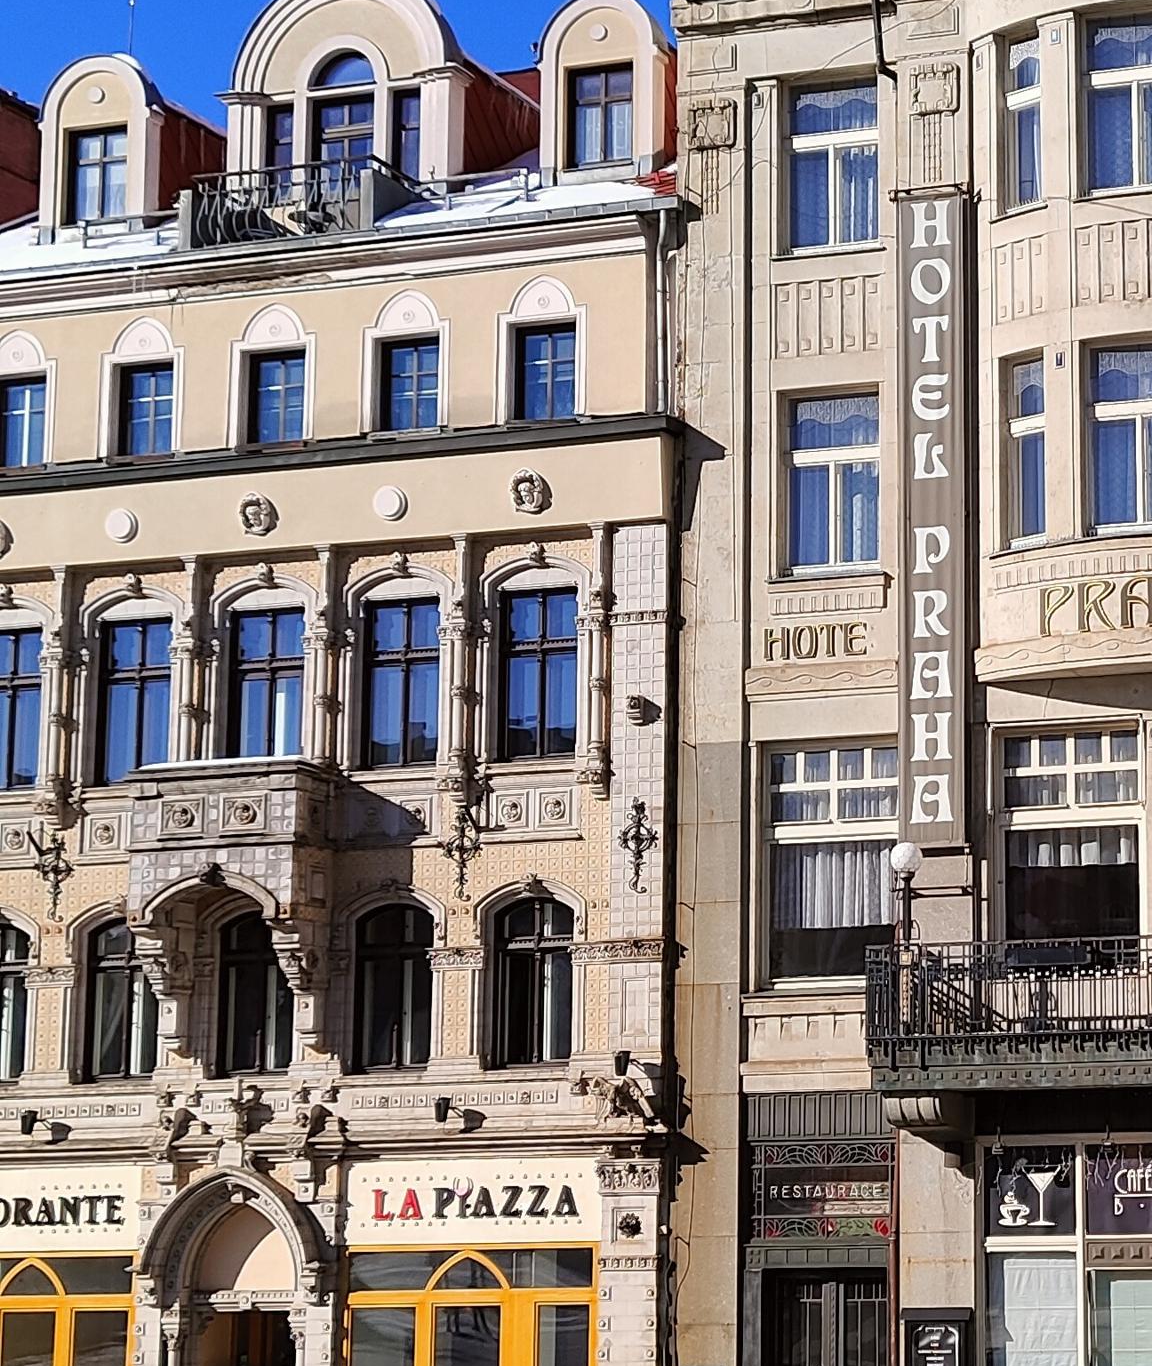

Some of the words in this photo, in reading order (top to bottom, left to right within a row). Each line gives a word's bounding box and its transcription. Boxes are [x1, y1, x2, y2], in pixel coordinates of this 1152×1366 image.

[909, 201, 952, 481] HOTEL
[909, 524, 954, 825] PRAHA
[371, 1187, 425, 1222] LA
[432, 1178, 580, 1220] PIAZZA
[1114, 1164, 1152, 1194] CAFÉ
